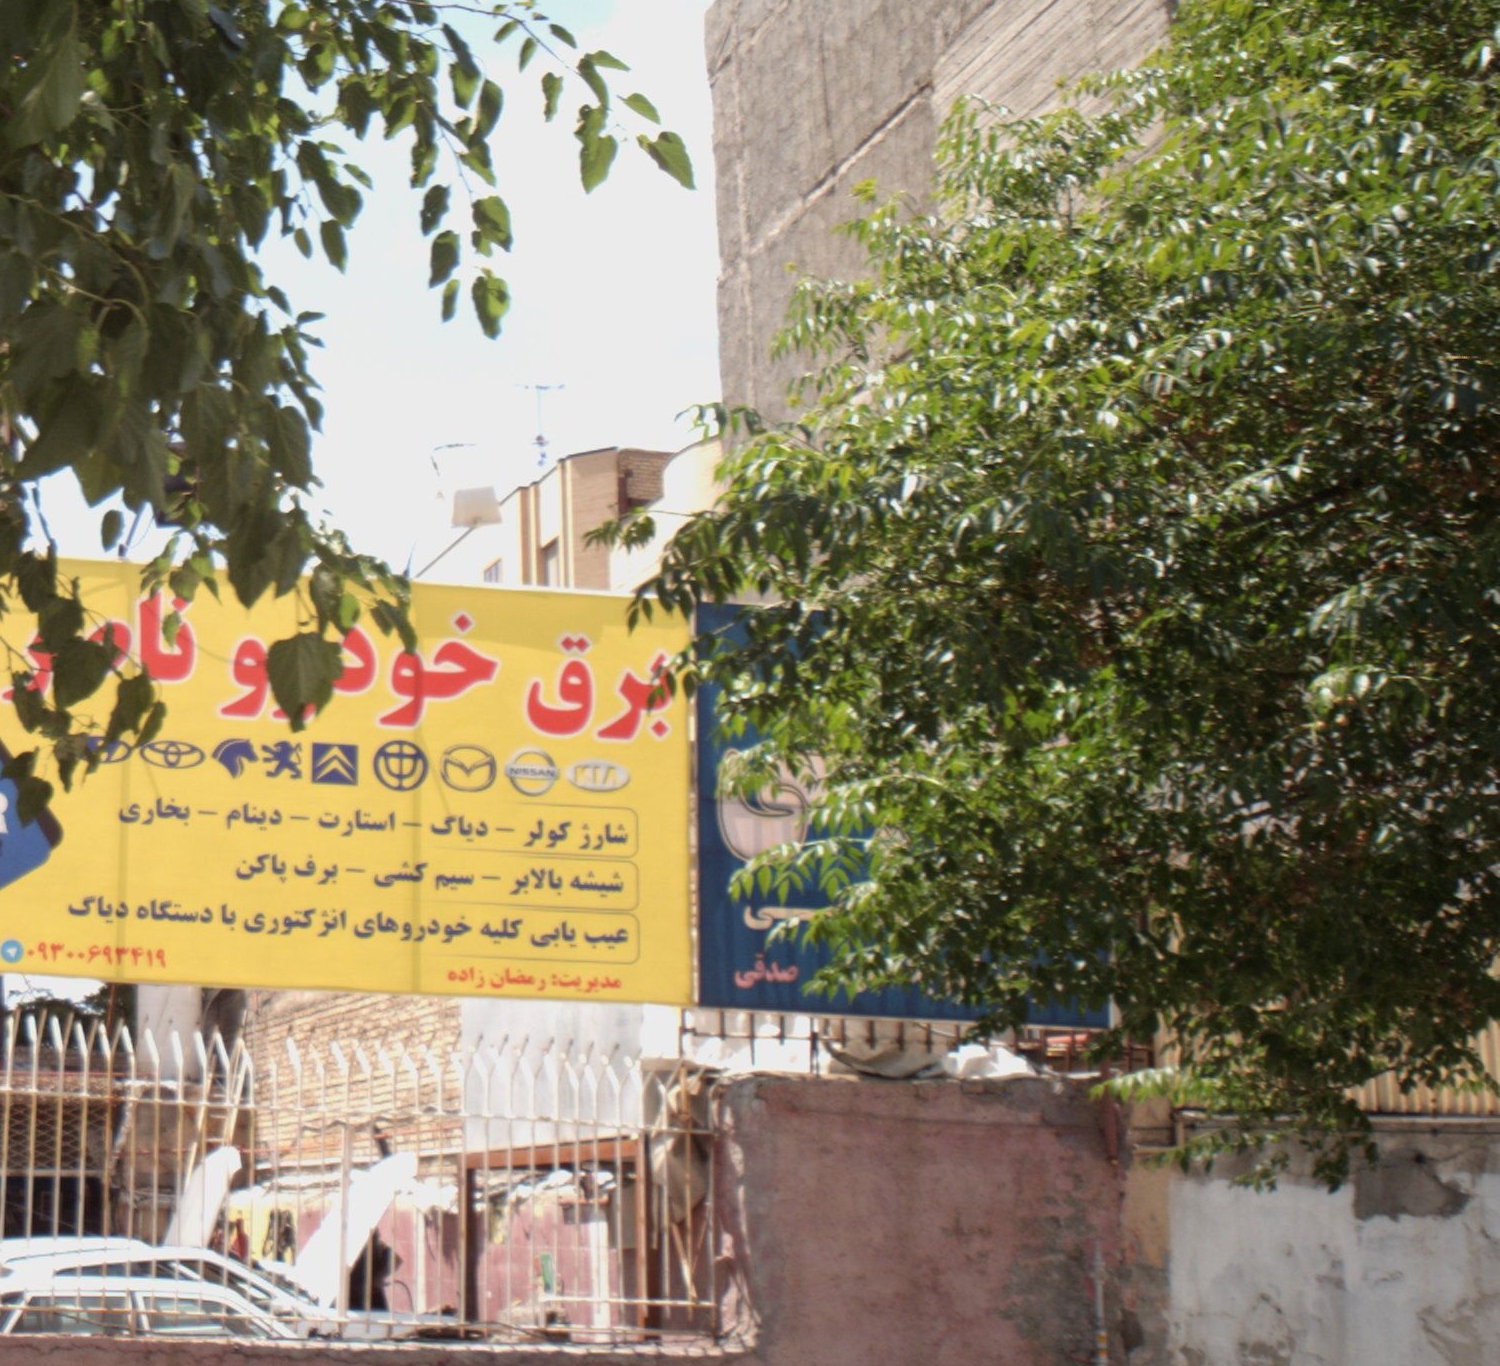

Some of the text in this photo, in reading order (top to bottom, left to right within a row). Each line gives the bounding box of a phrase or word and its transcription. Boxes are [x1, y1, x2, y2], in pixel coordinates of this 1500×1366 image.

[220, 612, 499, 727] خودو
[527, 635, 675, 741] برق
[509, 766, 556, 778] NISSAN
[118, 798, 629, 850] شارژ کولر دیاگ استارت دینام بخاری
[235, 853, 624, 896] شیشه بالابر سیم کشی برف پاکن
[67, 897, 629, 948] عیب یابی کلیه خودروهای انژکتوری با دستگاه دیاگ
[447, 965, 486, 989] زاده
[490, 970, 547, 993] رمضان
